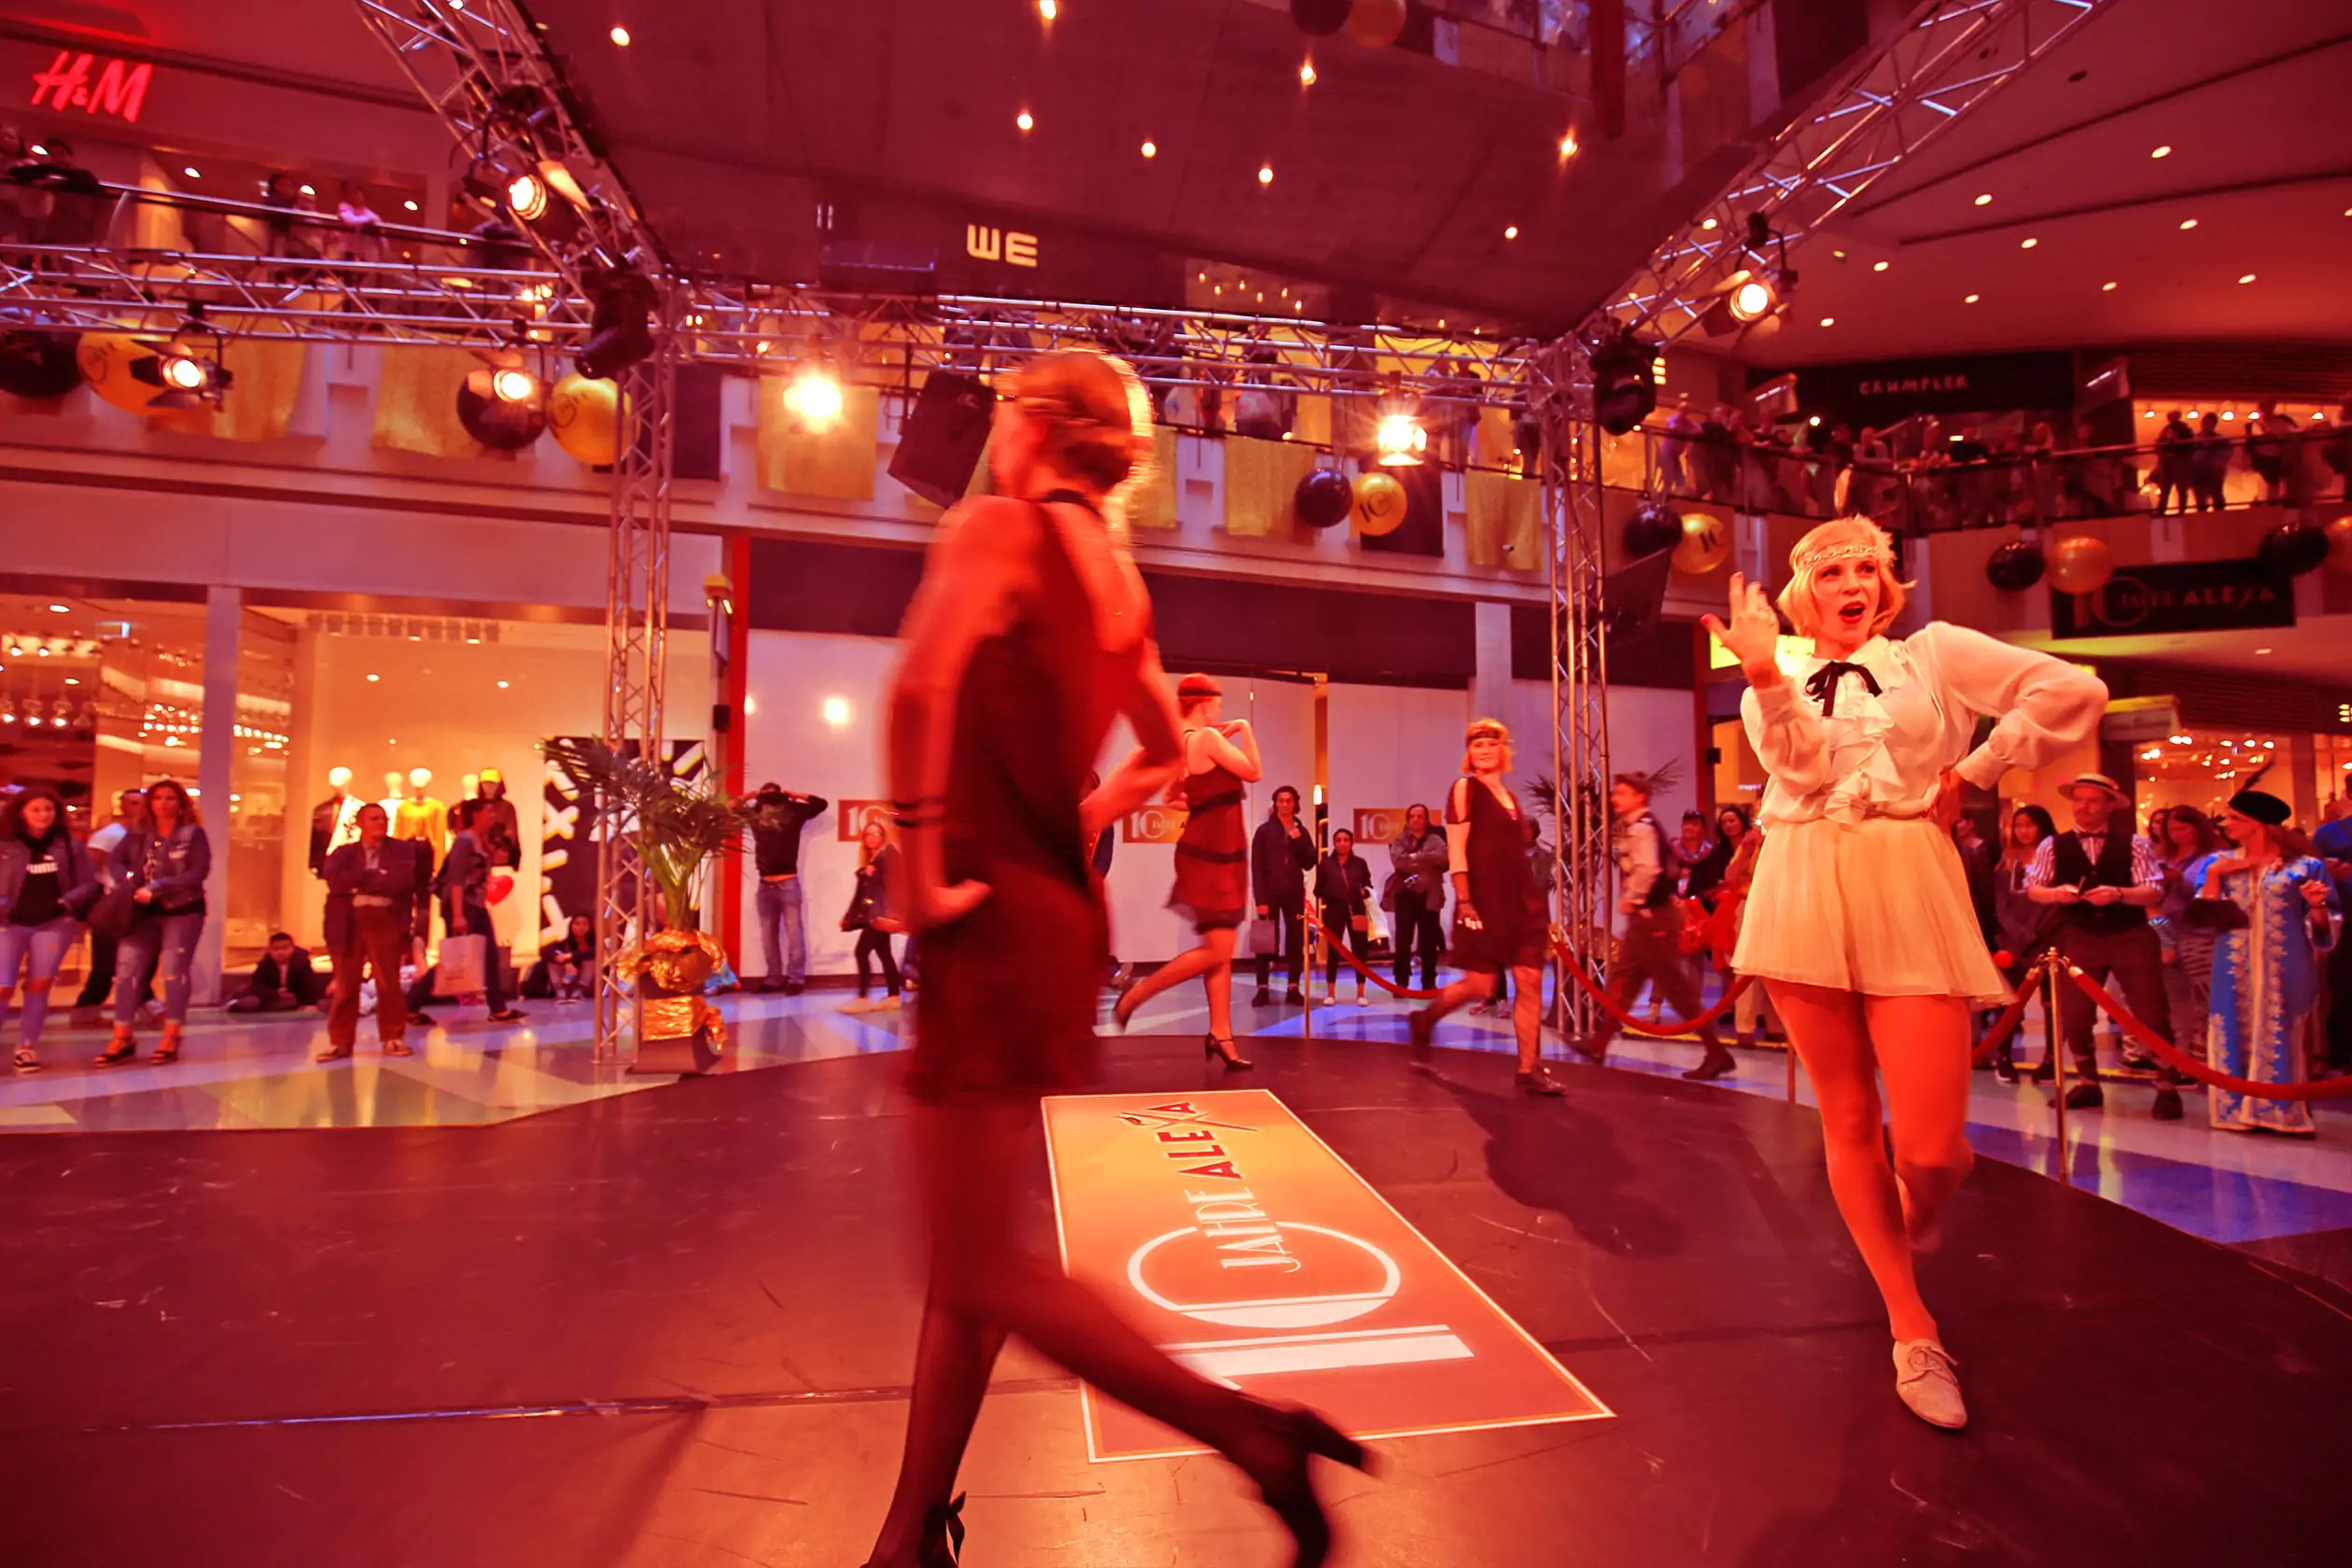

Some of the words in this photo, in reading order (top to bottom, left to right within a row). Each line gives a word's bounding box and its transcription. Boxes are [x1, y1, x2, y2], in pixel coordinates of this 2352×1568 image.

[31, 50, 153, 123] H&M
[967, 224, 1038, 267] WE
[1118, 1101, 1258, 1180] ALEXA
[1183, 1186, 1301, 1274] JAHRE
